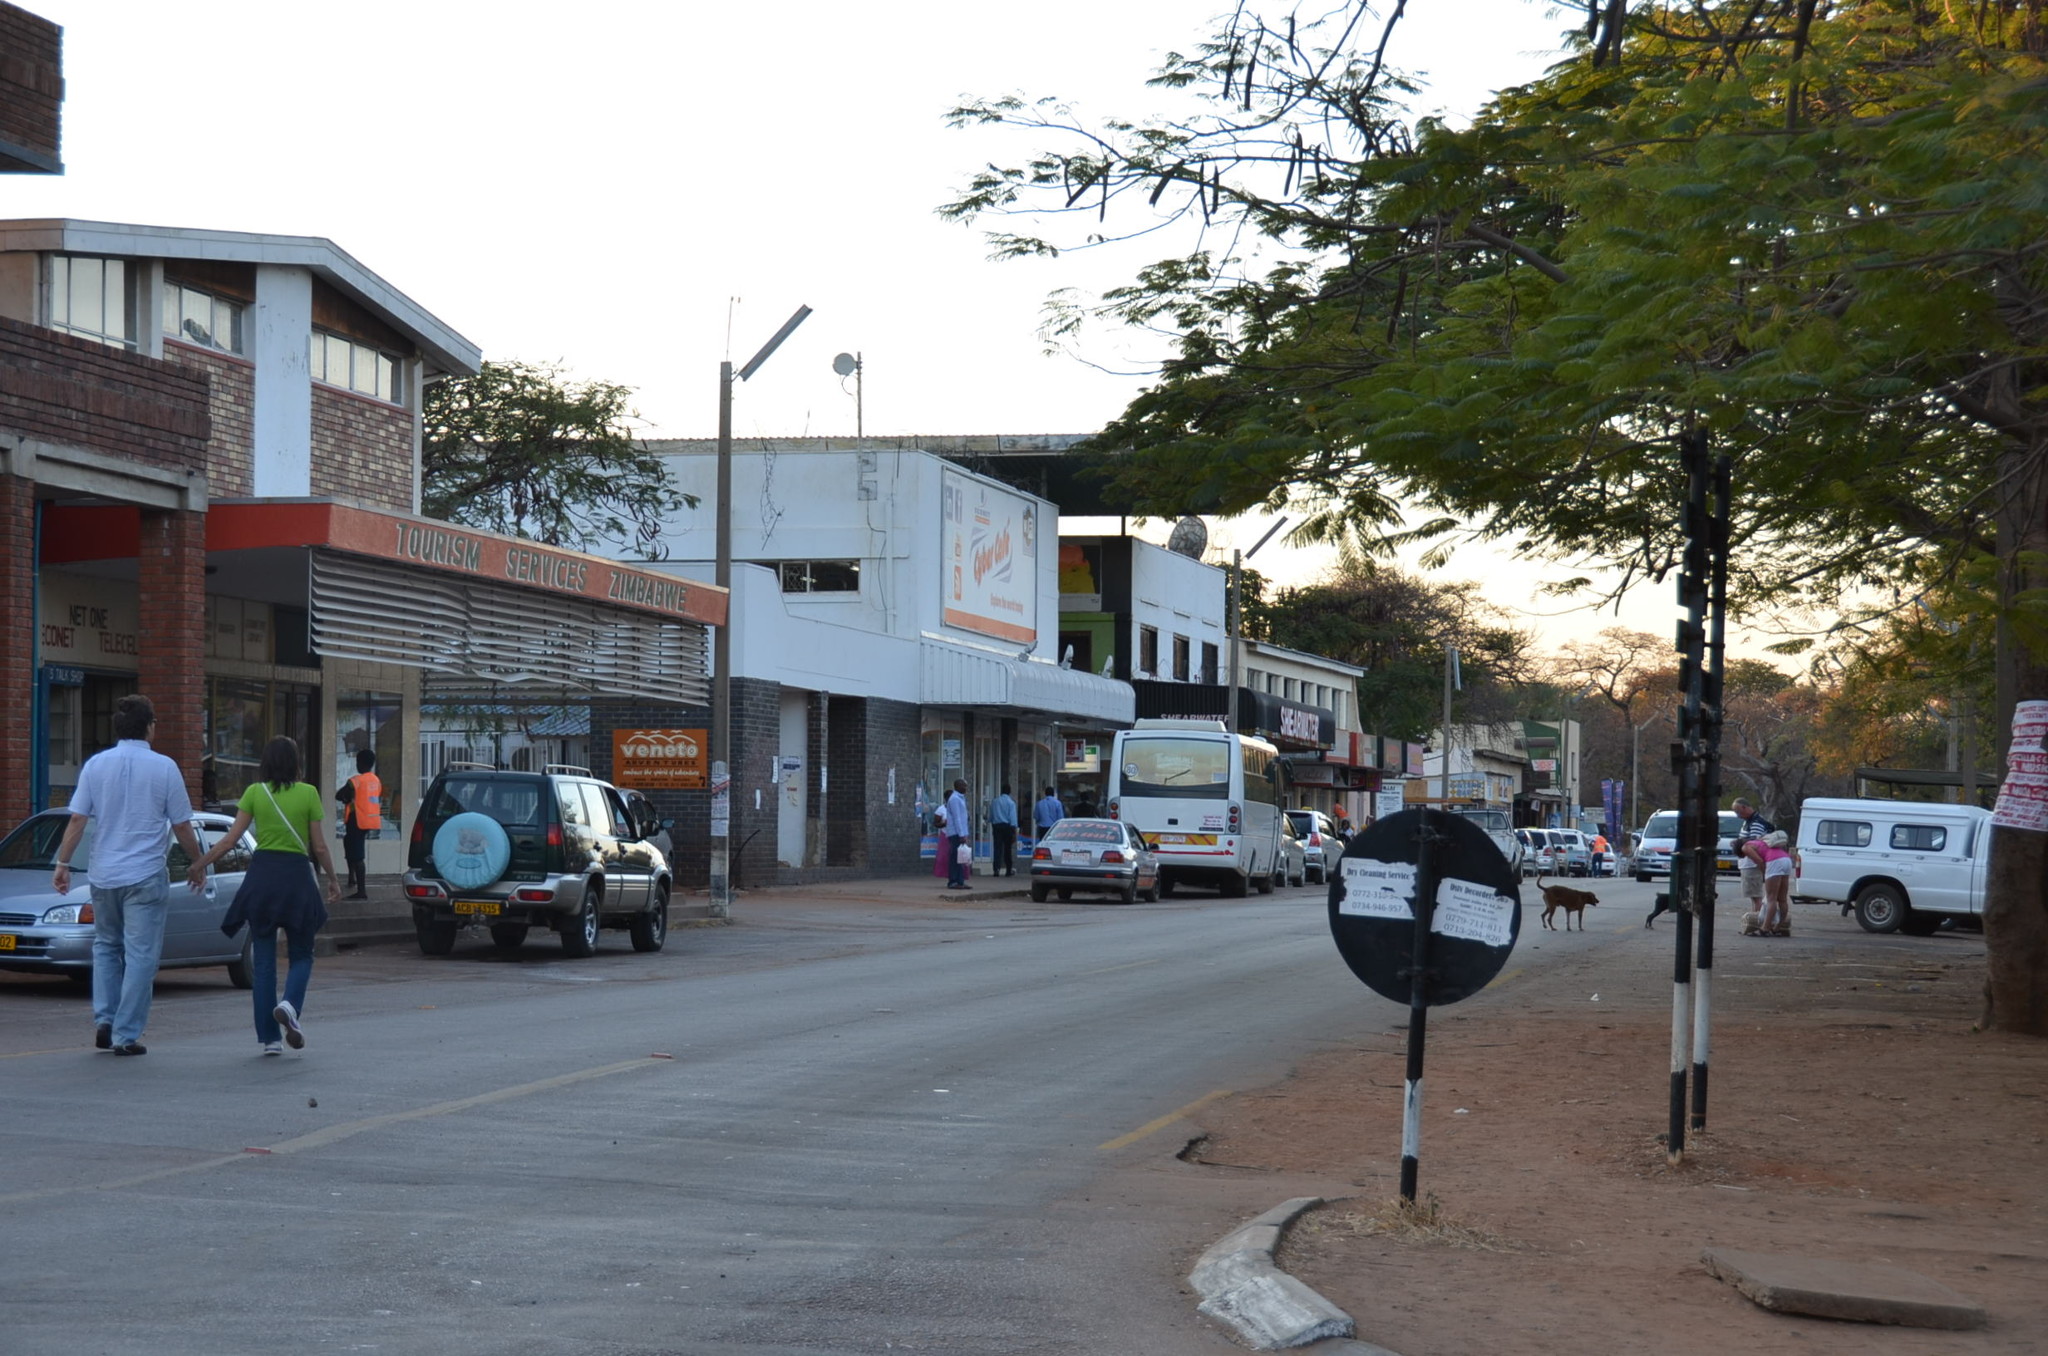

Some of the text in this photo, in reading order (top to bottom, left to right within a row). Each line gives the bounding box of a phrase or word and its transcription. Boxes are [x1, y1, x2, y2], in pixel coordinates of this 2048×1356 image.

[396, 523, 688, 613] TOURISM SERVICES ZIMBABWE
[973, 543, 993, 588] Cyber
[69, 604, 109, 629] NET ONE
[99, 631, 139, 655] TELECEL
[56, 668, 68, 681] TALK
[70, 669, 85, 682] SHOP
[1280, 705, 1319, 741] SHEARWATER
[620, 741, 699, 758] veneto
[1126, 765, 1137, 774] 80
[1346, 868, 1358, 877] Dry
[1359, 869, 1387, 879] Cleaning
[456, 903, 472, 912] ACB
